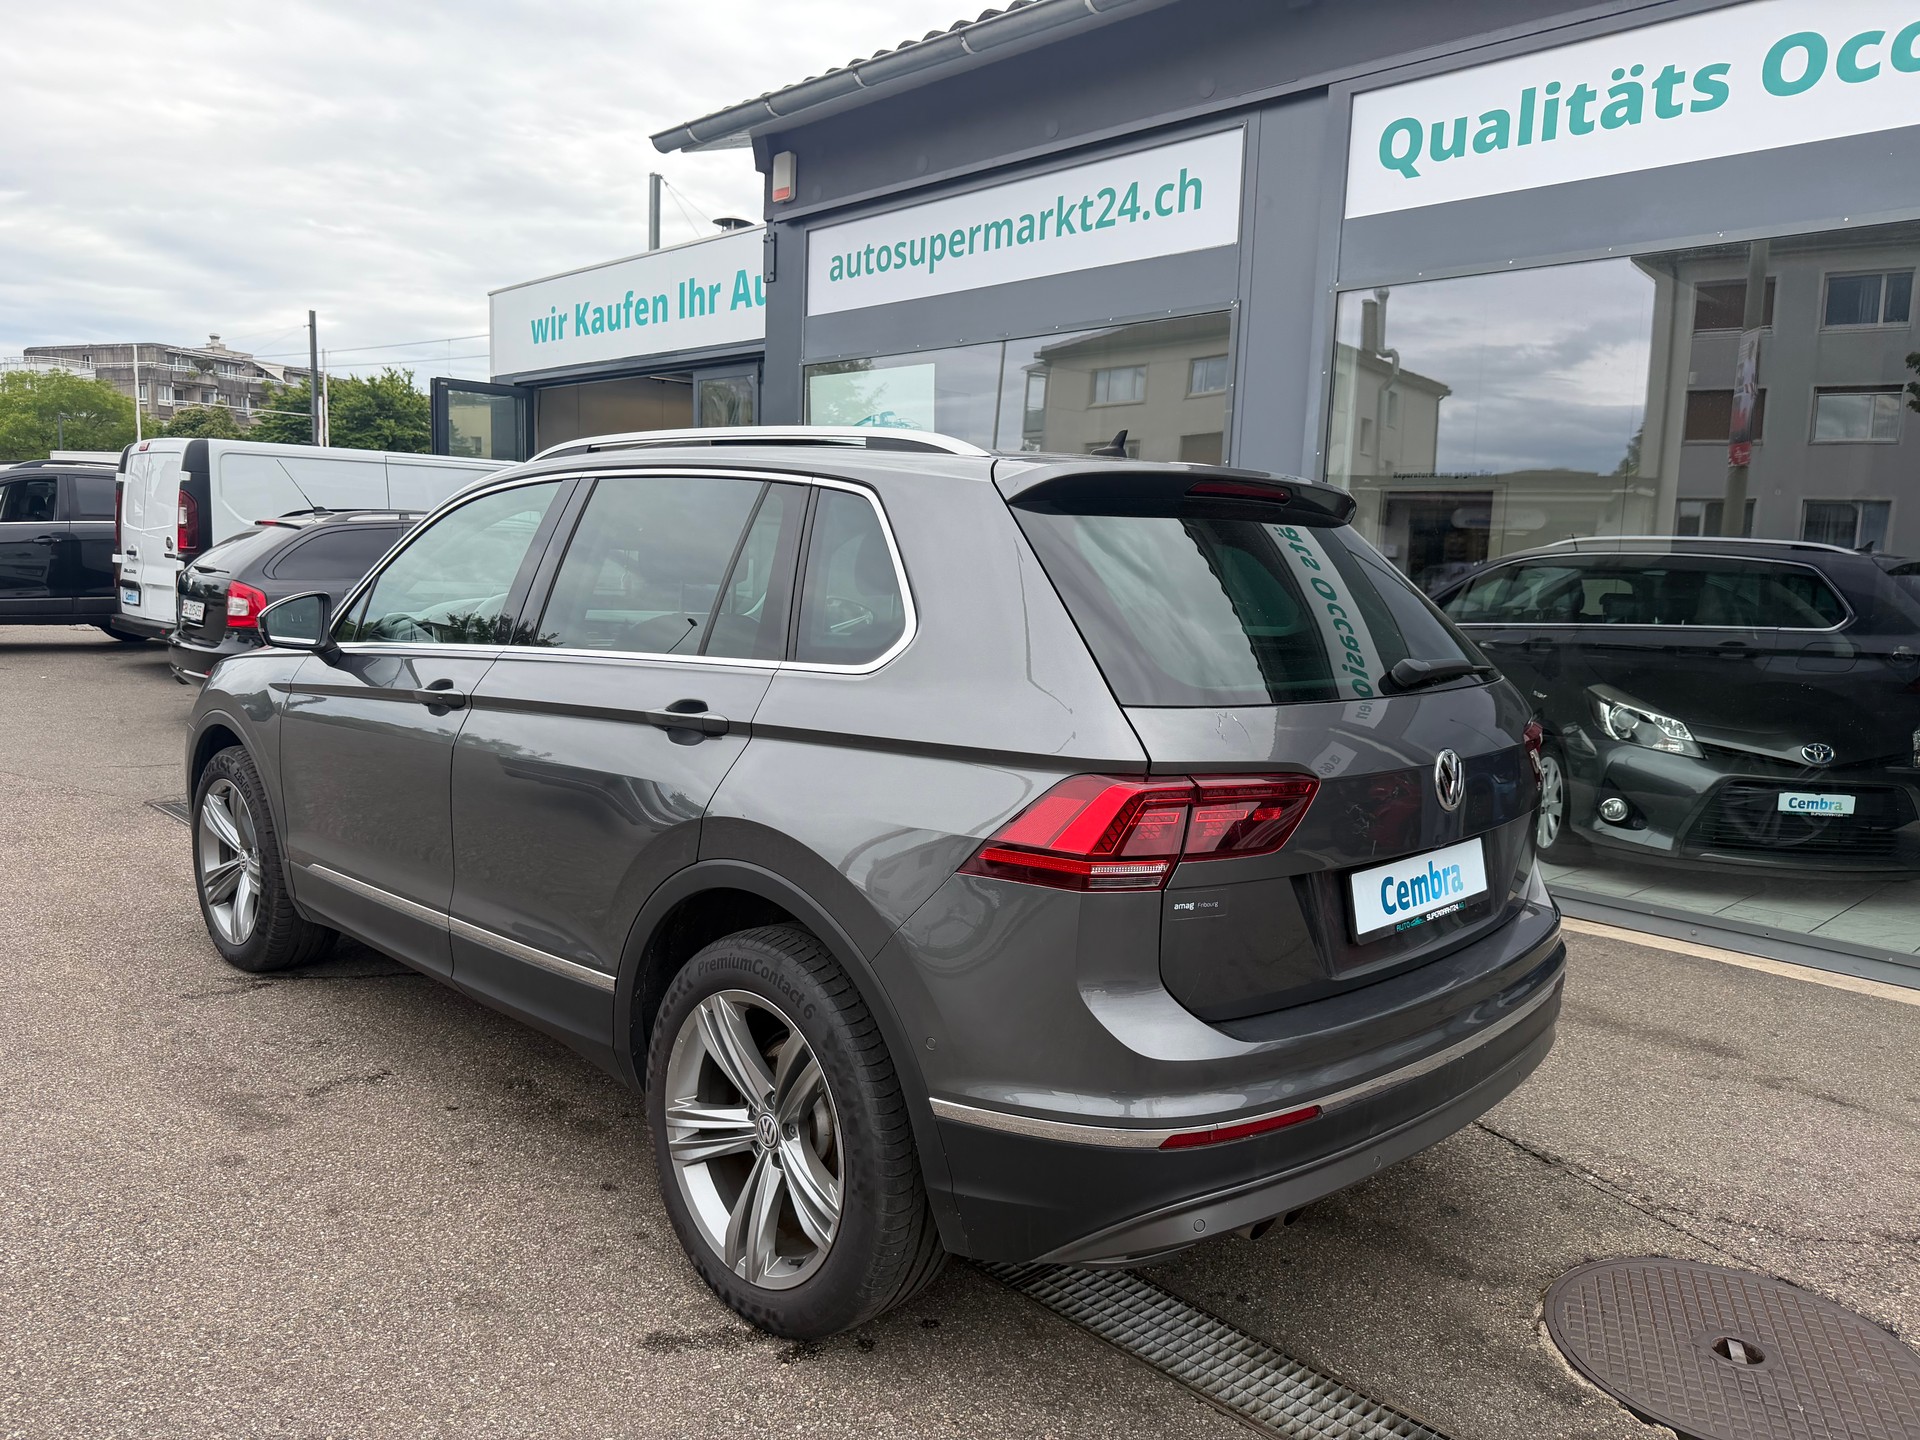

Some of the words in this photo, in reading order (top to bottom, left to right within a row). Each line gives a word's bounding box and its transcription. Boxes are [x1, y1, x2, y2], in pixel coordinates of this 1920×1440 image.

[1378, 62, 1732, 180] Qualitäts
[829, 168, 1202, 282] autosupermarkt24.ch
[531, 306, 567, 344] wir
[575, 291, 668, 337] Kaufen
[678, 278, 721, 319] Ihr
[1788, 797, 1843, 811] Cembra
[1173, 902, 1195, 911] amag
[1381, 861, 1463, 915] Cembra
[698, 953, 806, 1008] PremiumContact
[804, 1003, 817, 1020] 6
